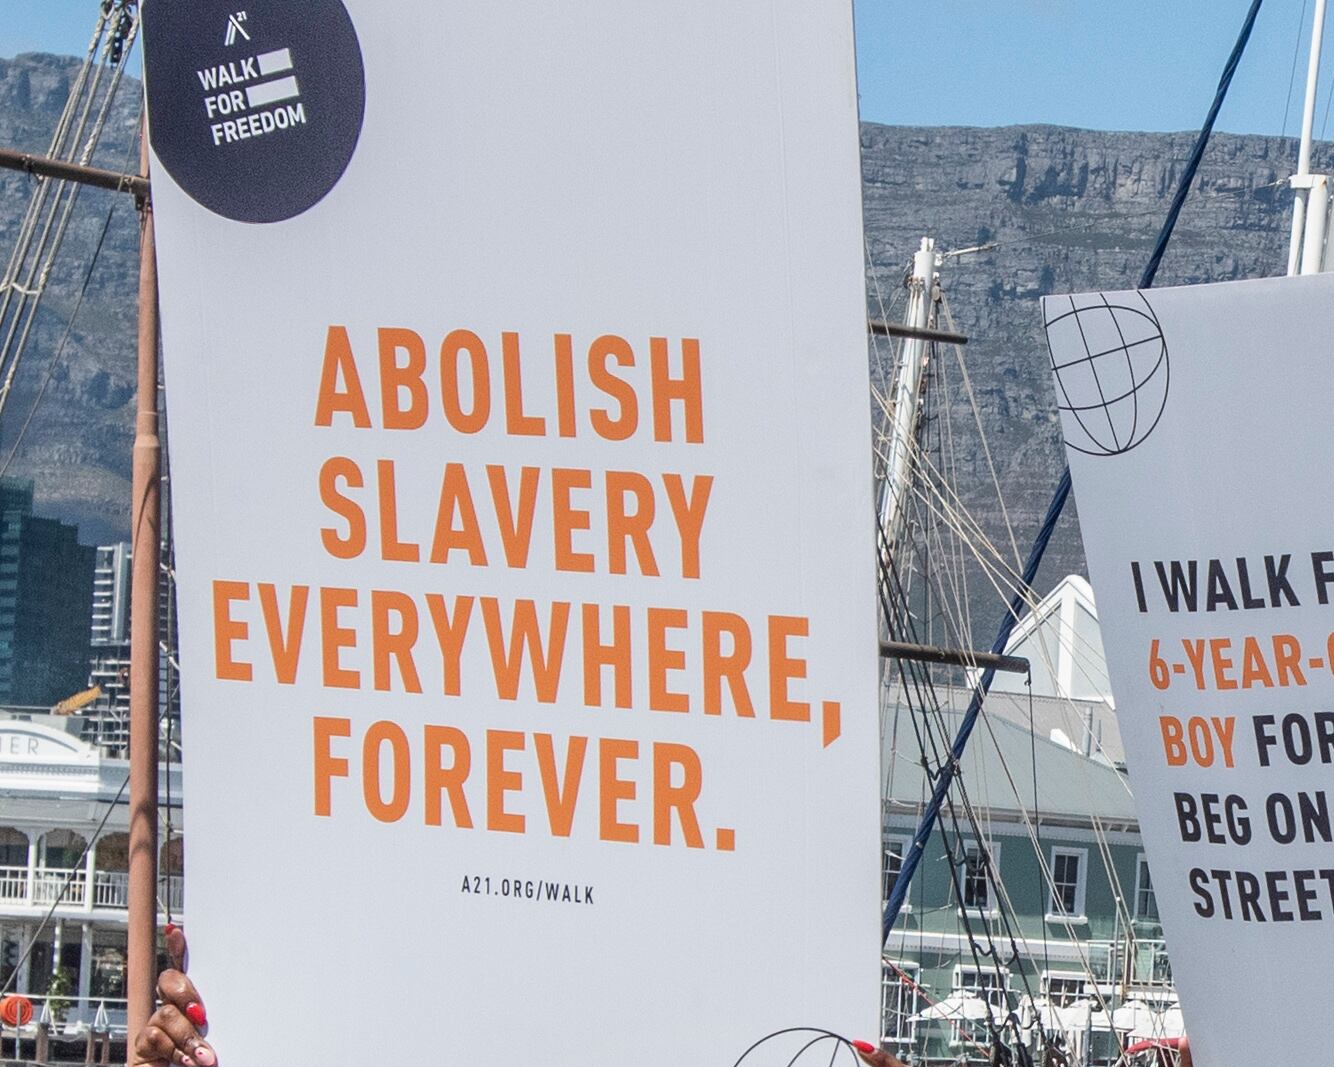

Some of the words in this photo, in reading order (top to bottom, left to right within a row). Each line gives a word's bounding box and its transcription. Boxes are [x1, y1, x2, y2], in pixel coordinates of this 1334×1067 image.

[197, 57, 258, 91] WALK
[204, 90, 246, 118] FOR
[210, 103, 306, 145] FREEDOM
[315, 325, 704, 444] ABOLISH
[319, 456, 714, 578] SLAVERY
[1131, 561, 1148, 613] I
[1154, 554, 1299, 613] WALK
[213, 579, 841, 749] EVERYWHERE,
[1160, 715, 1236, 769] BOY
[313, 716, 736, 851] FOREVER.
[1174, 791, 1253, 847] BEG
[1266, 790, 1333, 844] ON
[461, 875, 595, 904] A21.ORG/WALK
